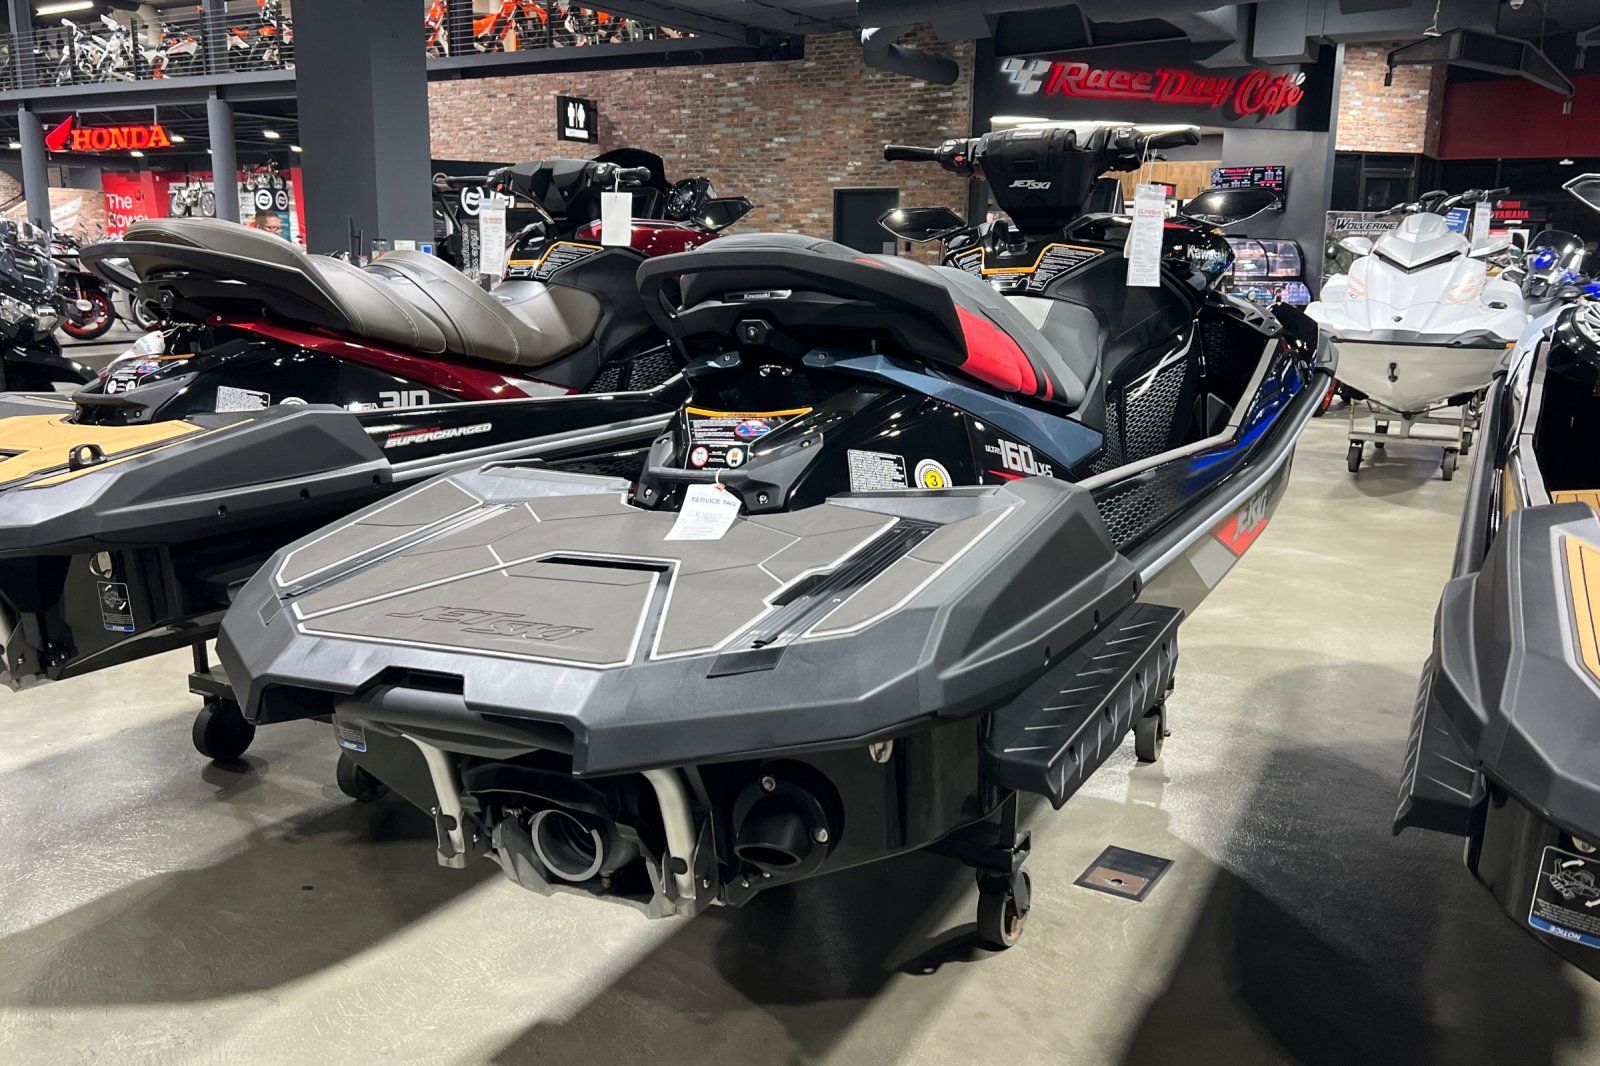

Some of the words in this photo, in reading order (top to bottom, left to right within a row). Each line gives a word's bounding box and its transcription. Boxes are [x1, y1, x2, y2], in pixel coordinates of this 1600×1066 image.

[1047, 61, 1152, 98] Race
[1155, 68, 1237, 107] Day
[71, 125, 171, 151] HONDA
[105, 193, 133, 209] The
[1494, 210, 1530, 219] YAMAHA
[1334, 217, 1399, 232] WOLVERINE
[379, 389, 430, 409] 310
[384, 422, 493, 449] SUPERCHARGED
[997, 438, 1036, 475] 160
[930, 474, 938, 487] 3
[690, 496, 721, 505] SERVICE
[1549, 925, 1581, 941] NOTICE
